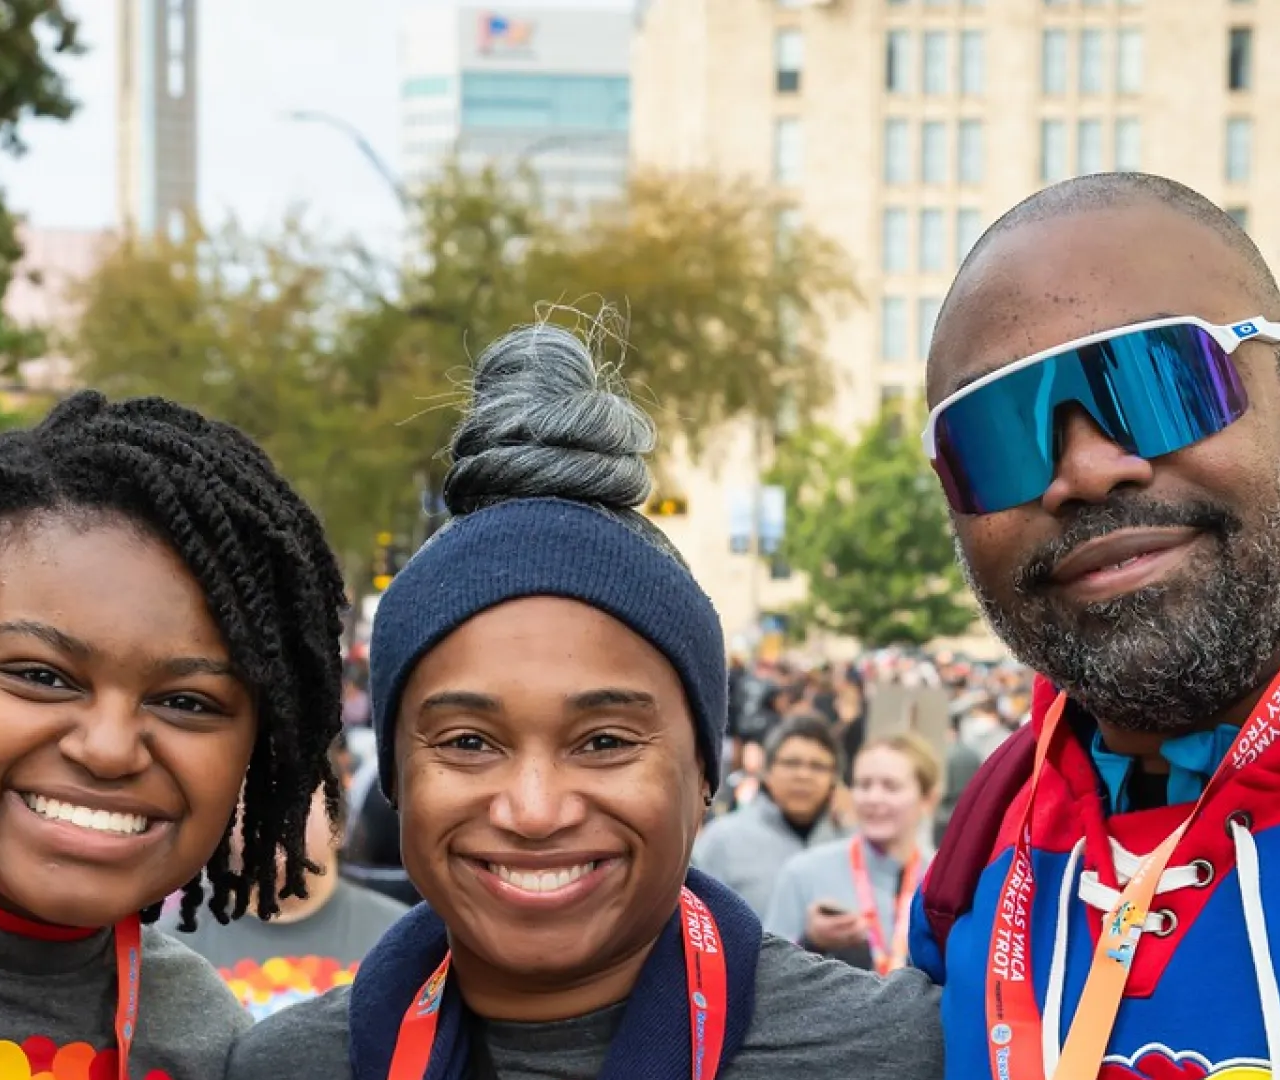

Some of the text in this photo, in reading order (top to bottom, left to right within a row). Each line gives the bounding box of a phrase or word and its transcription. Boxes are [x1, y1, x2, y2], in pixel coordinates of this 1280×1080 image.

[1233, 717, 1268, 764] TROT
[687, 909, 704, 951] TROT
[992, 928, 1011, 981] TROT
[1010, 932, 1026, 981] YMCA
